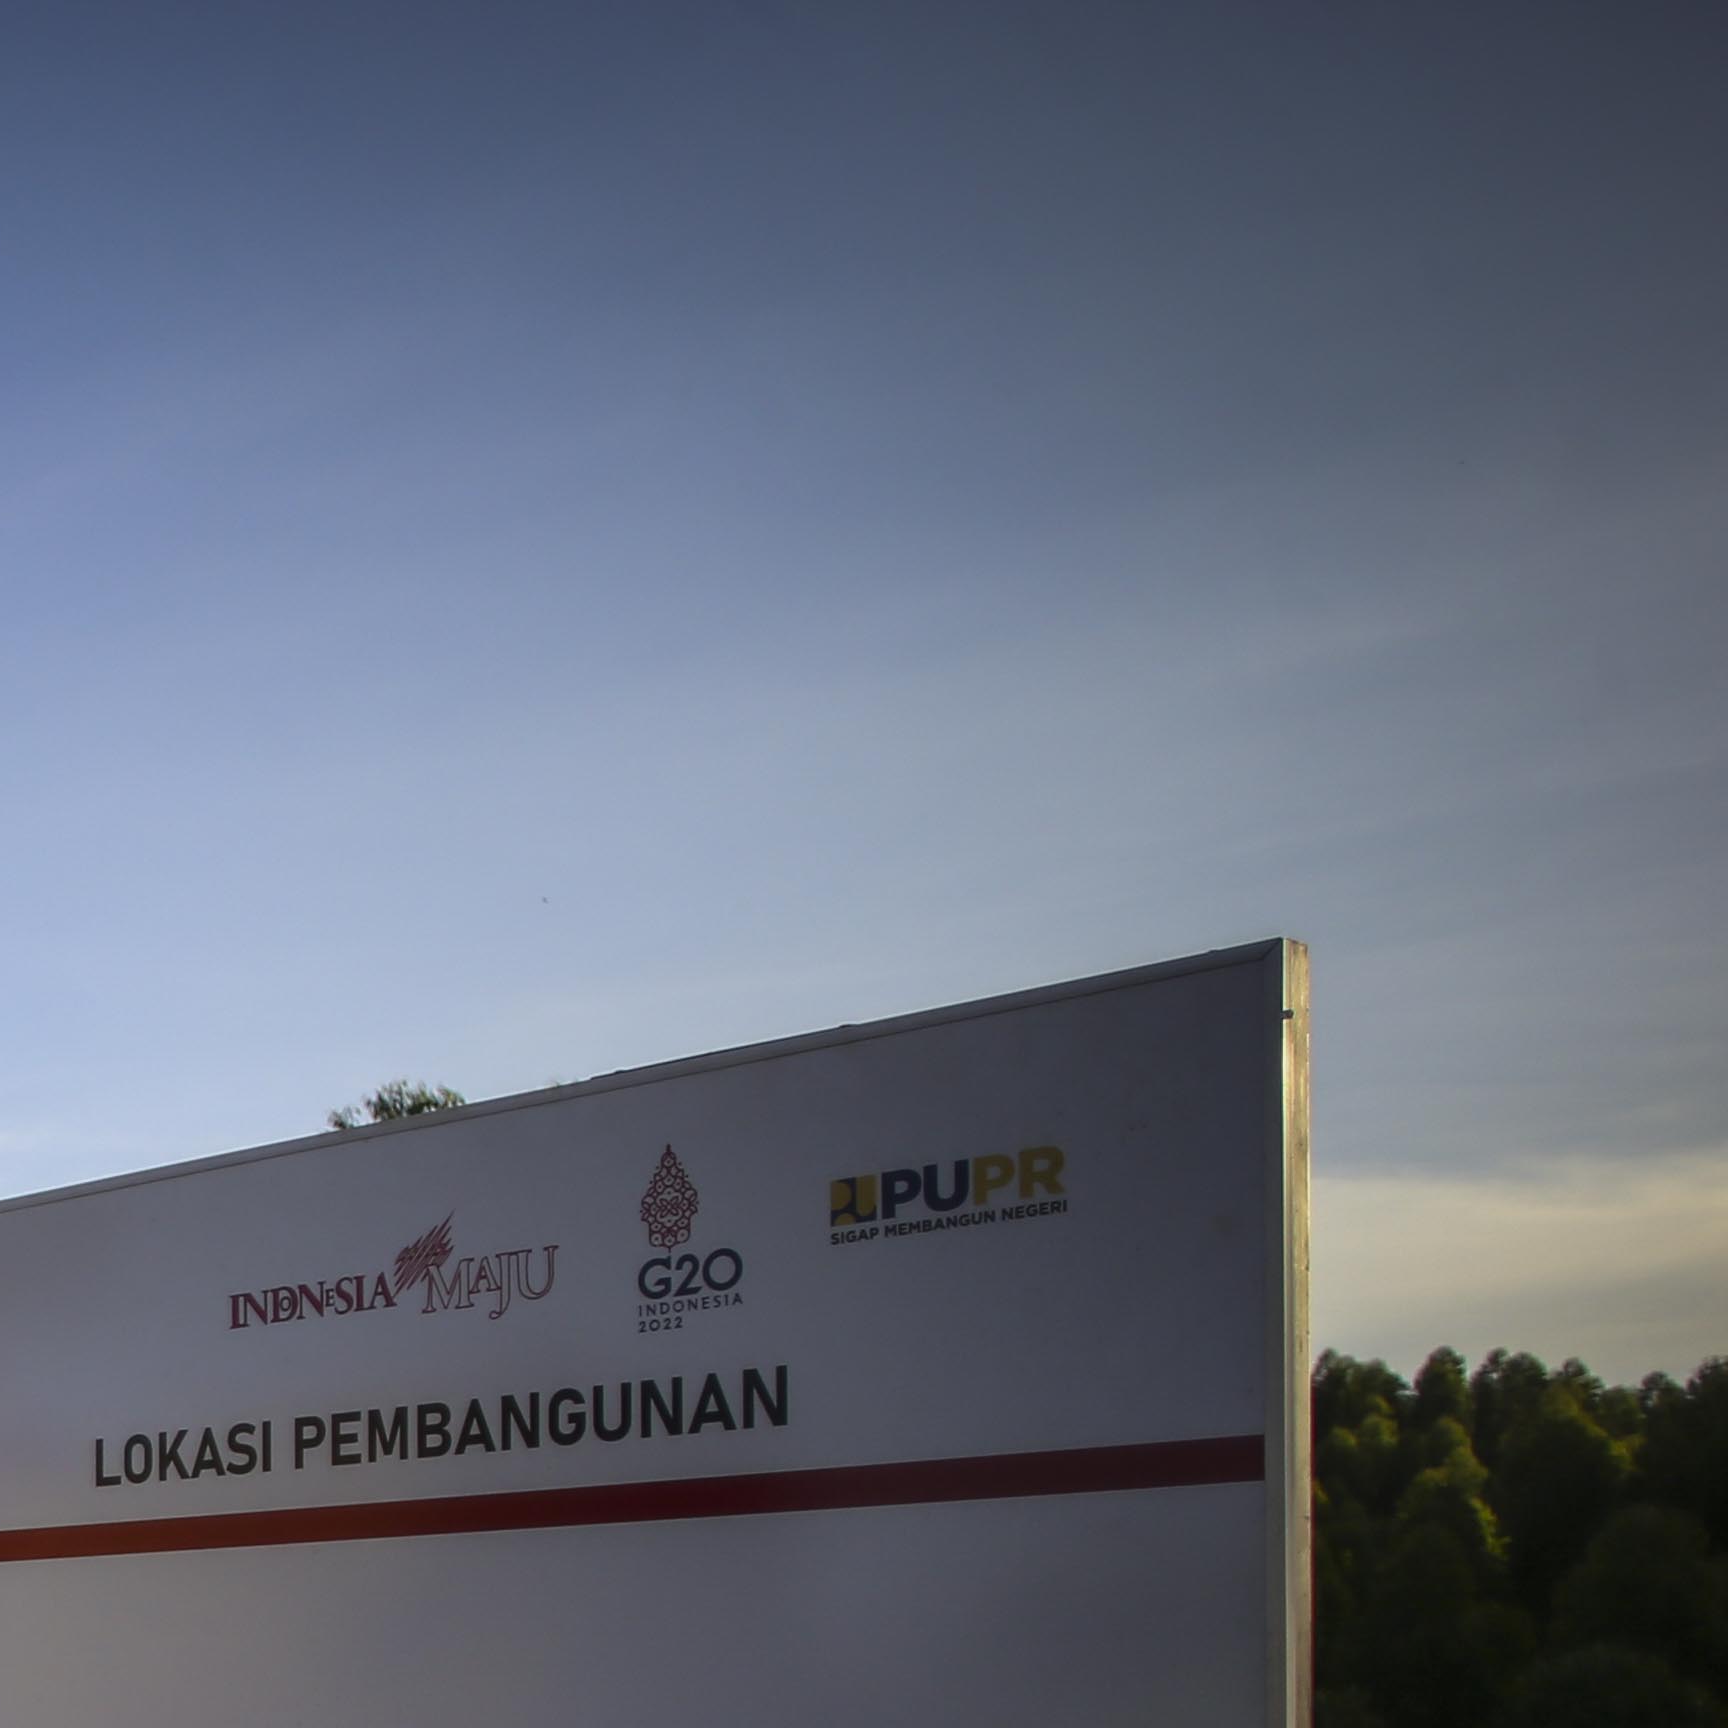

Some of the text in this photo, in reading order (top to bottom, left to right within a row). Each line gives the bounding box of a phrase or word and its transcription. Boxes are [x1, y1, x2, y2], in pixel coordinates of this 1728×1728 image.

[882, 1146, 1065, 1219] PUPR
[830, 1200, 1067, 1245] SIGAP MEMBANGUN NEGERI
[421, 1245, 559, 1320] MAJU
[638, 1248, 743, 1299] G20
[638, 1292, 743, 1317] INDONESIA
[638, 1316, 683, 1333] 2022
[94, 1364, 788, 1488] LOKASI PEMBANGUNAN
